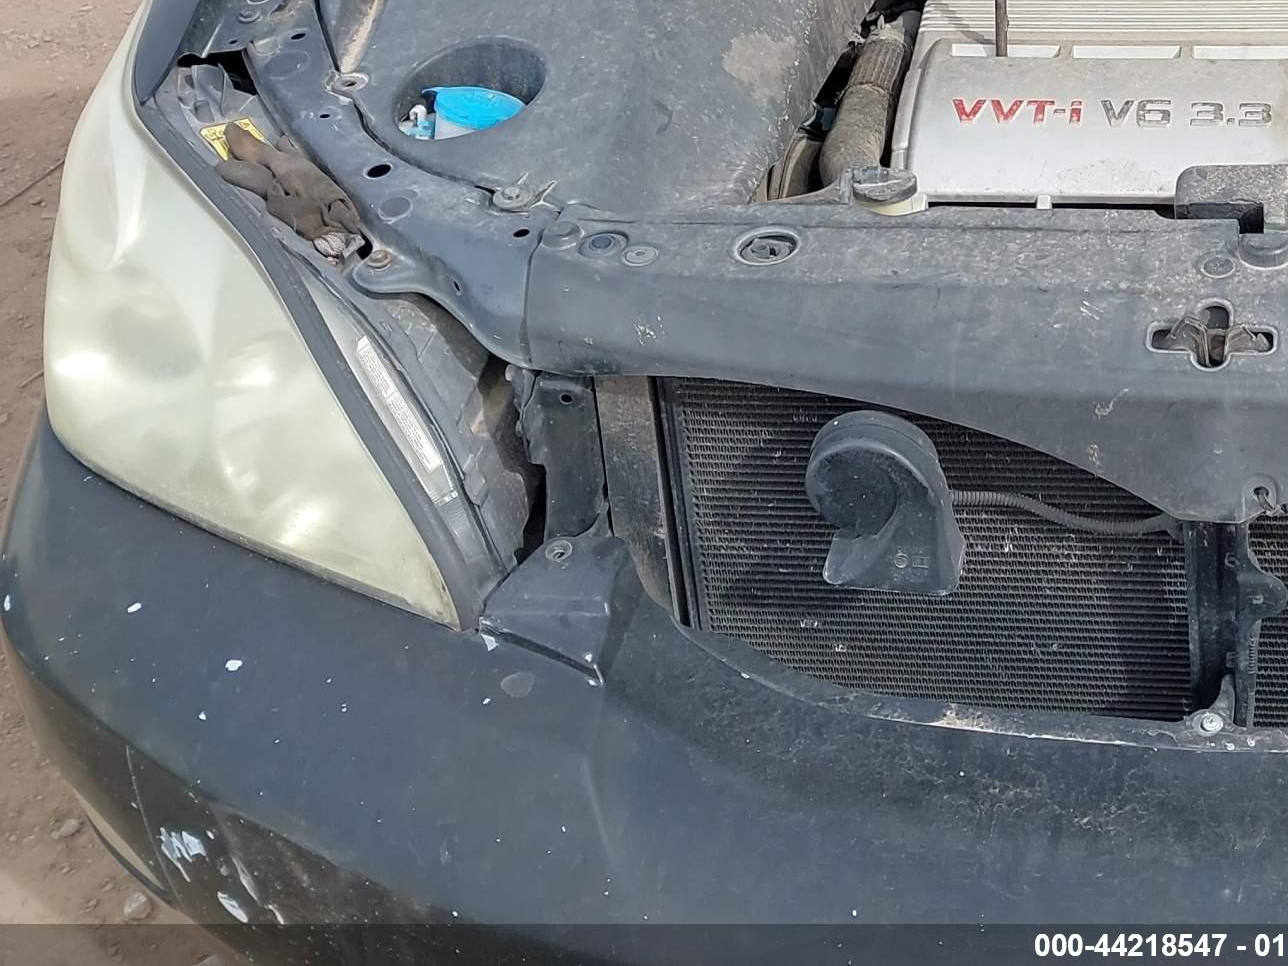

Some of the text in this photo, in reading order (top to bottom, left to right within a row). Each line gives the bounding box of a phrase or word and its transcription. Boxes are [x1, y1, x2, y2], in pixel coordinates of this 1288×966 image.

[952, 98, 1273, 128] VVT-i V6 3.3
